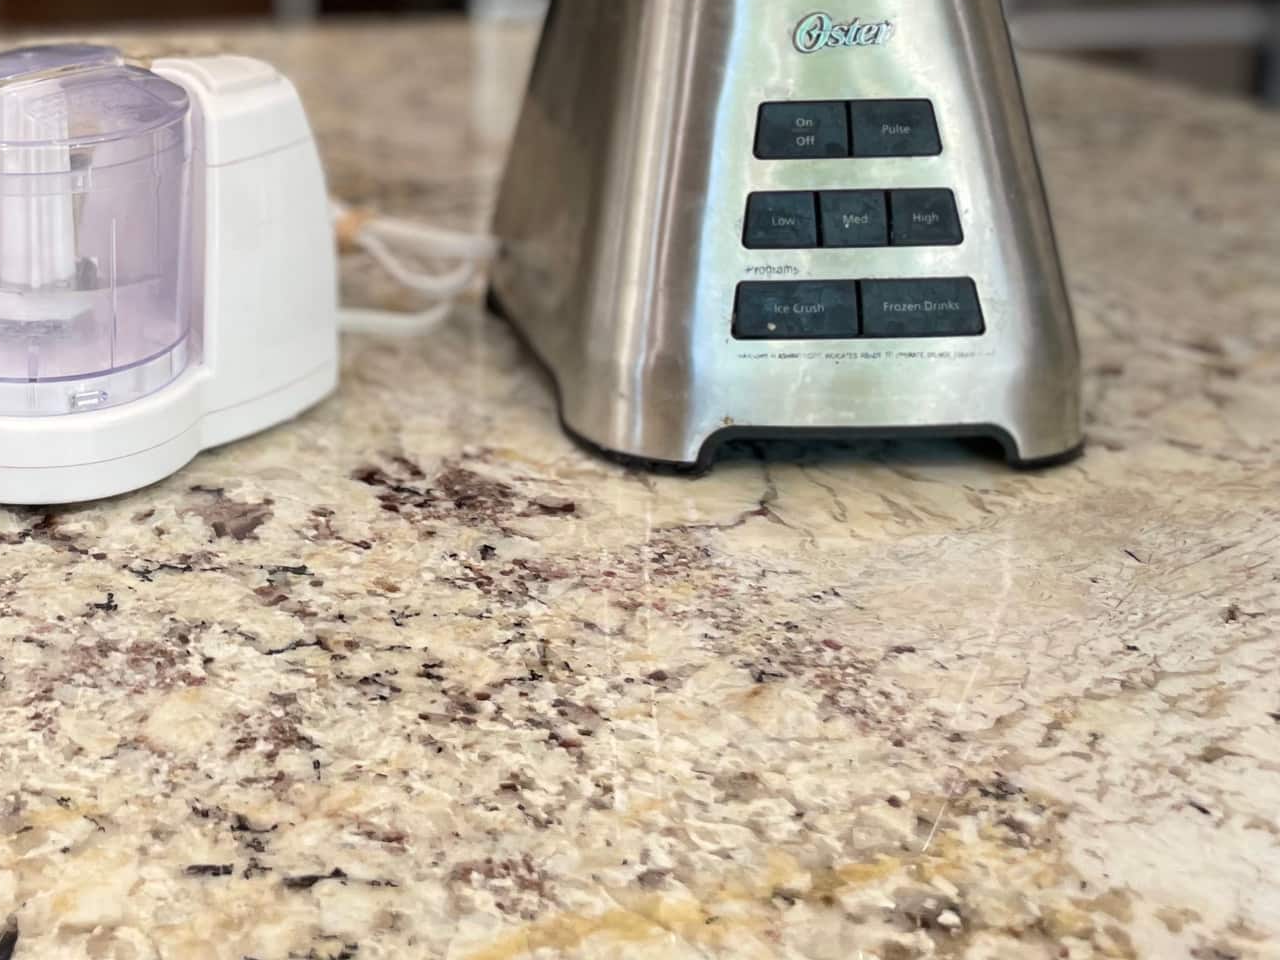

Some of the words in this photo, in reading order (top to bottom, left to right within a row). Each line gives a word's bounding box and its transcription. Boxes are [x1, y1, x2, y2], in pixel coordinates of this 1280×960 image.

[792, 12, 895, 53] Oster
[796, 118, 813, 128] On
[882, 124, 912, 135] Pulse
[796, 135, 815, 146] Off
[774, 303, 789, 313] Ice
[793, 303, 825, 313] Crush
[883, 302, 921, 312] Frozen
[924, 301, 959, 311] Drinks
